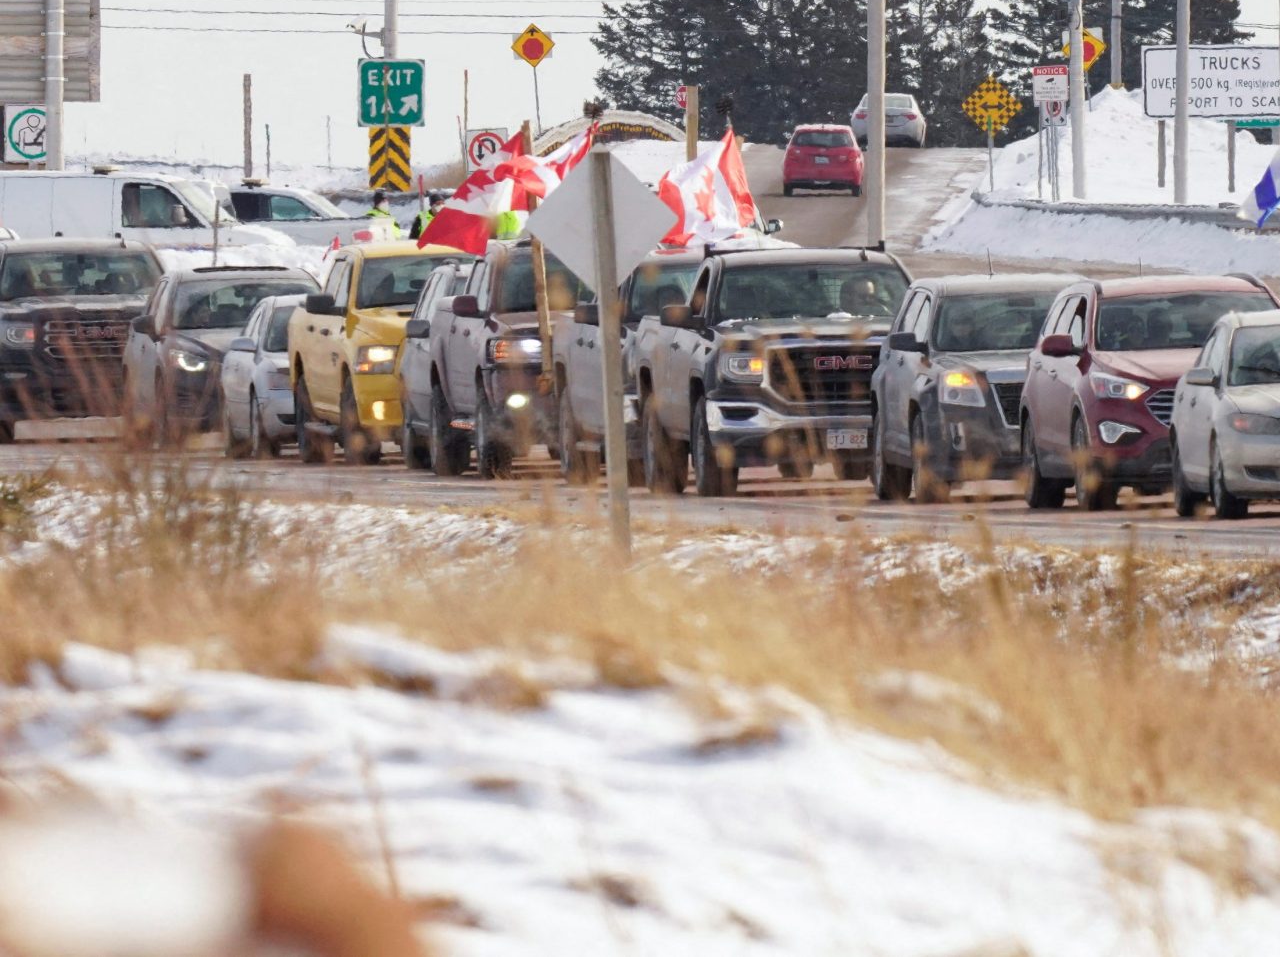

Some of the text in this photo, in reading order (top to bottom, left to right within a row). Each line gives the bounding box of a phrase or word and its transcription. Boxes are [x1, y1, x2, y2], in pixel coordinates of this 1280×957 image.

[1036, 67, 1065, 75] NOTICE
[1200, 56, 1261, 71] TRUCKS
[367, 69, 415, 87] EXIT
[365, 95, 396, 118] 1A
[1169, 96, 1218, 109] RPORT
[1228, 96, 1243, 108] TO
[814, 355, 873, 371] GMC
